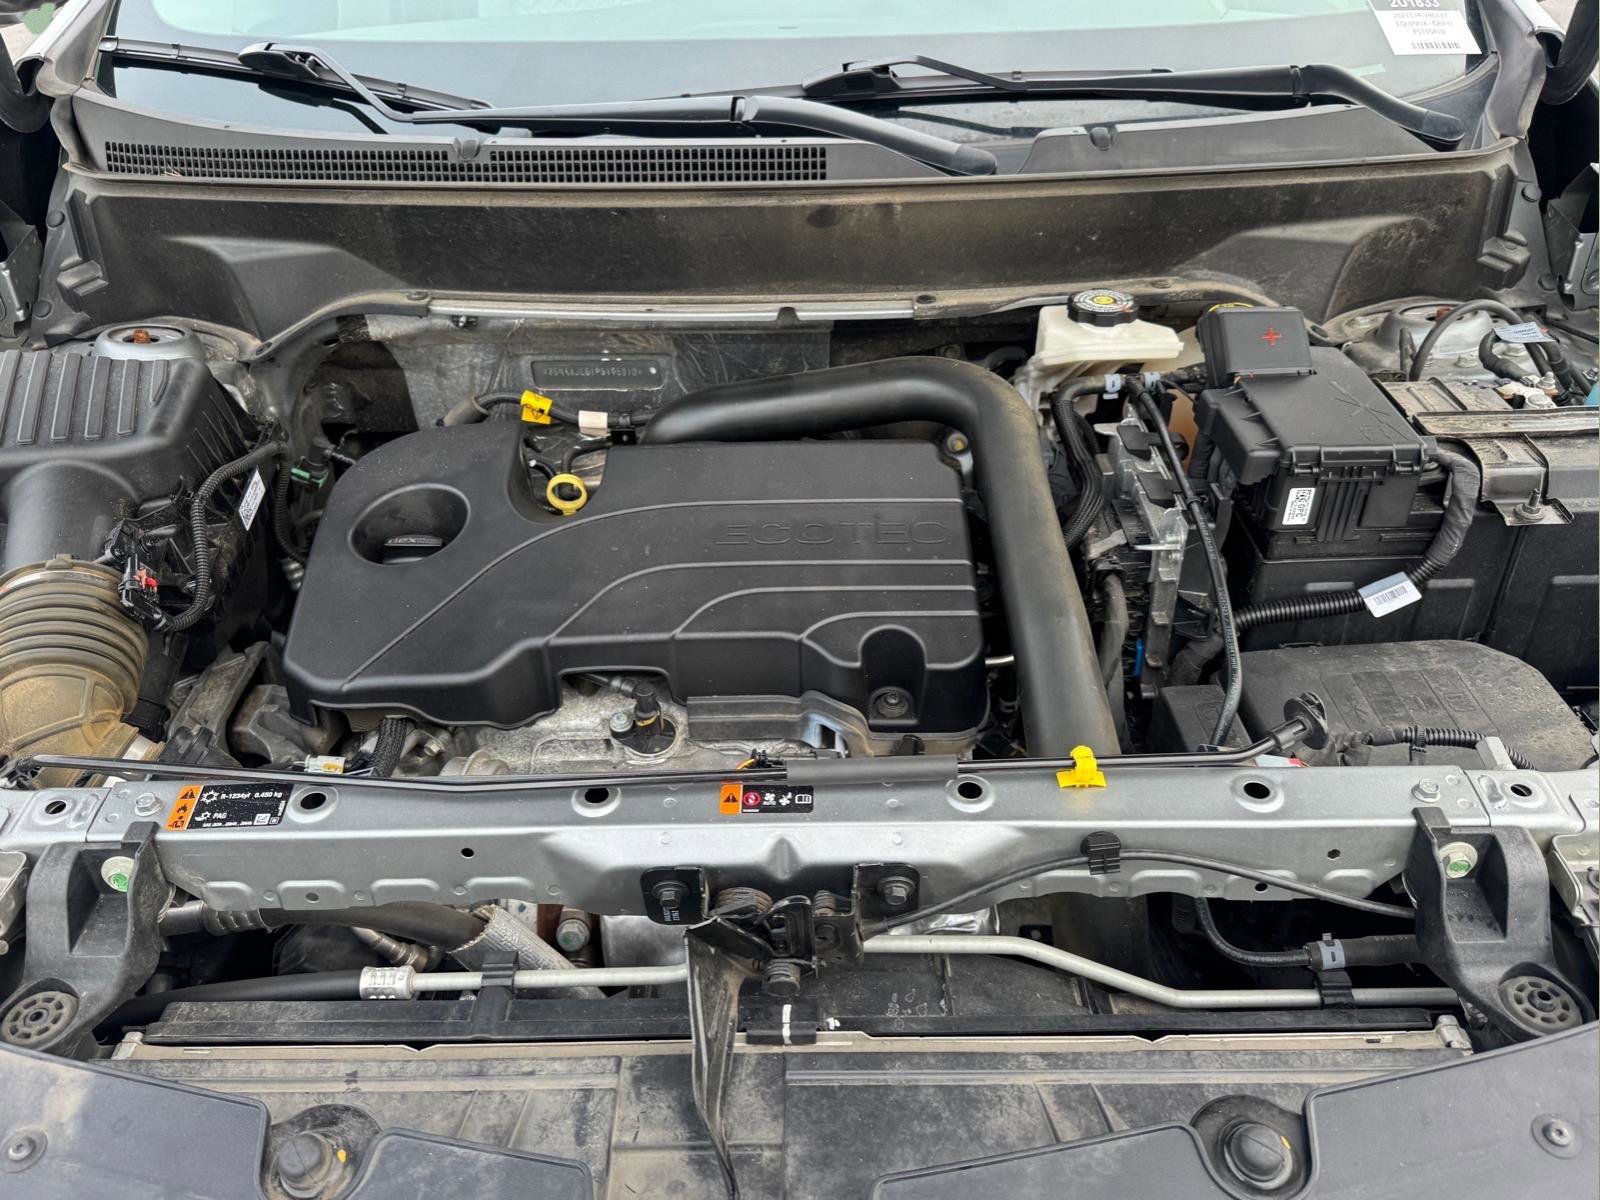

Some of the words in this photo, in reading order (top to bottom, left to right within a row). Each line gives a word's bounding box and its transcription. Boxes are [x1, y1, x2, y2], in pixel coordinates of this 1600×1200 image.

[714, 521, 949, 545] ECOTEC
[220, 792, 251, 800] R-1234yf
[273, 791, 283, 799] kg
